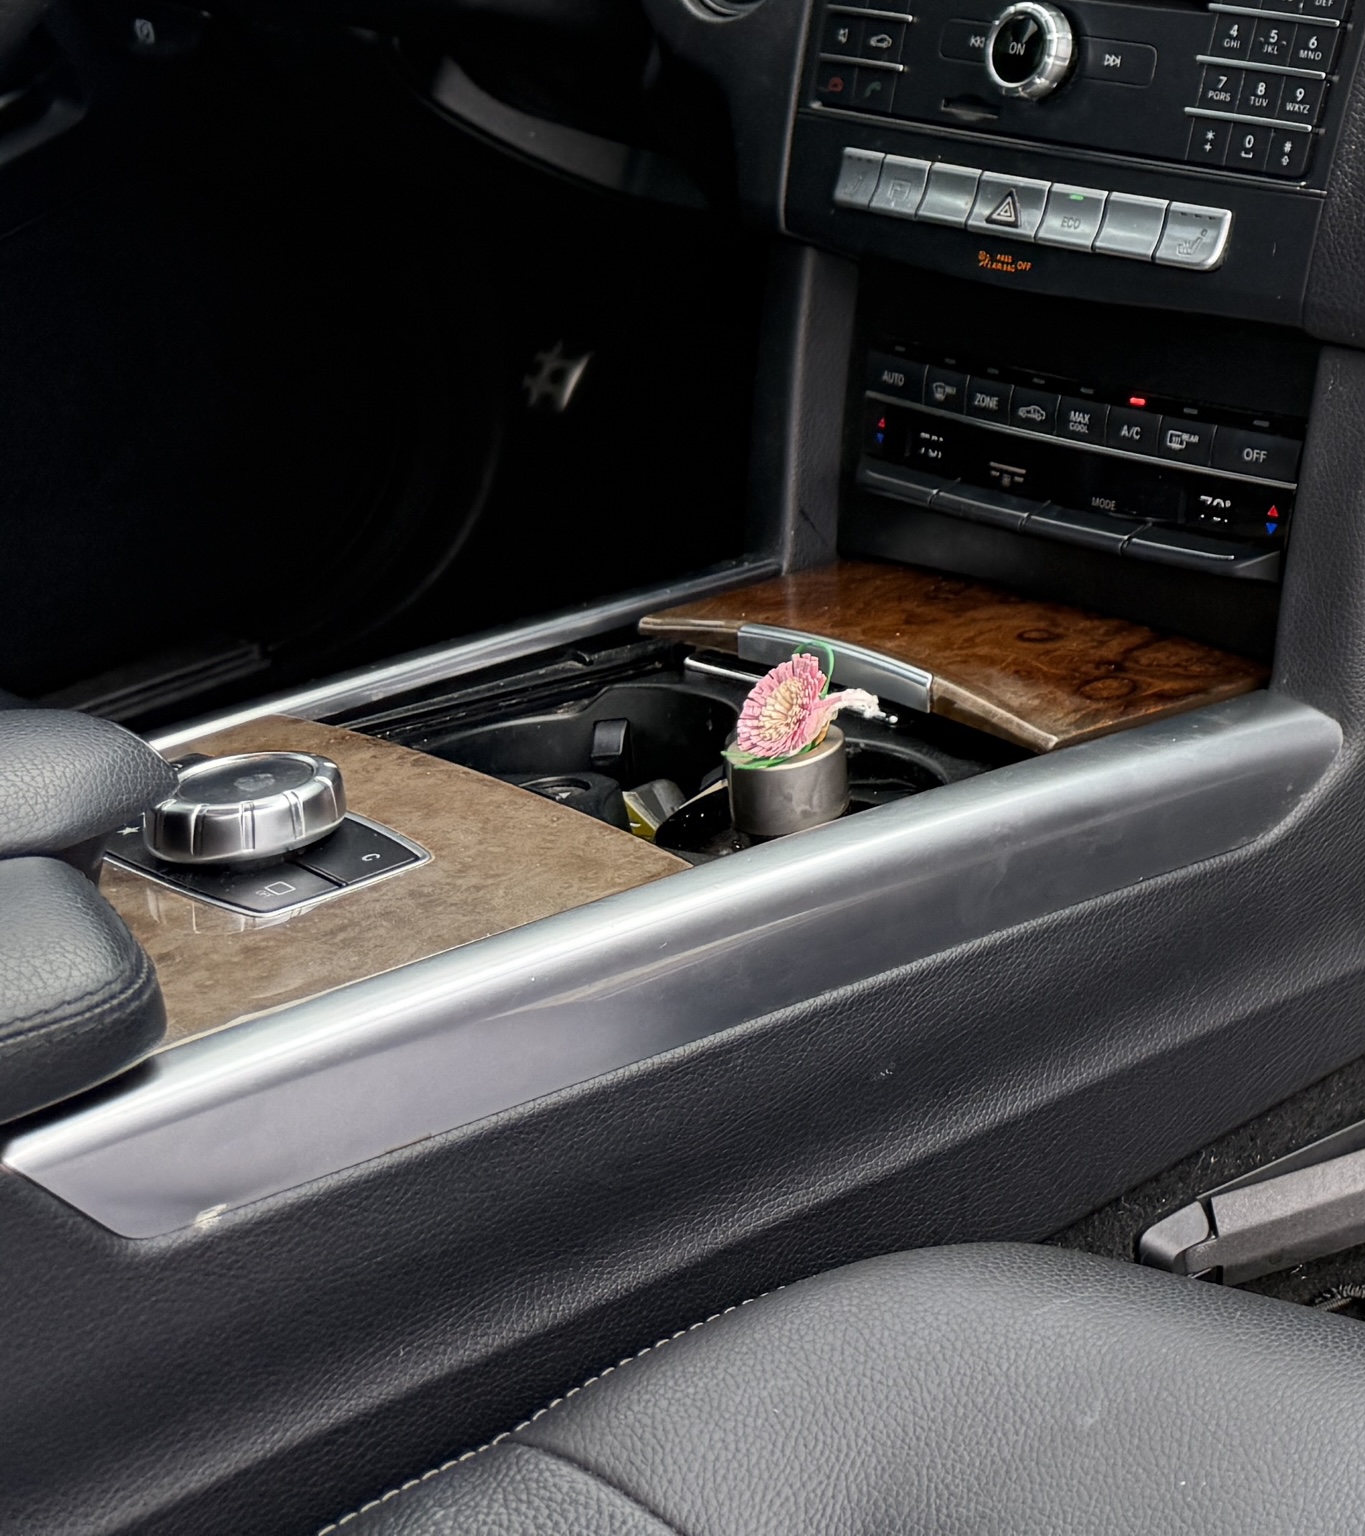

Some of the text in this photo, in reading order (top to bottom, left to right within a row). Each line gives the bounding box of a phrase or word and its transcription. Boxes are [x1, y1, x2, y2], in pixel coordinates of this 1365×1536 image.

[1229, 24, 1239, 38] 4
[1269, 29, 1279, 43] 5
[1008, 41, 1026, 56] ON
[1223, 38, 1241, 49] GHI
[1308, 35, 1318, 49] 6
[1262, 44, 1279, 55] JKL
[1299, 49, 1322, 61] MNO
[1218, 75, 1228, 89] 7
[1256, 82, 1266, 96] 8
[1207, 90, 1231, 102] PQRS
[1249, 95, 1269, 107] TUV
[1295, 87, 1305, 102] 9
[1285, 102, 1310, 114] WXYZ
[1245, 134, 1255, 149] 0
[1061, 215, 1081, 230] ECO
[882, 370, 905, 387] AUTO
[974, 392, 999, 410] ZONE
[1070, 410, 1091, 425] MAX
[1069, 421, 1089, 434] COOL
[1120, 424, 1142, 441] A/C
[1243, 447, 1268, 463] OFF
[1091, 495, 1117, 511] MODE
